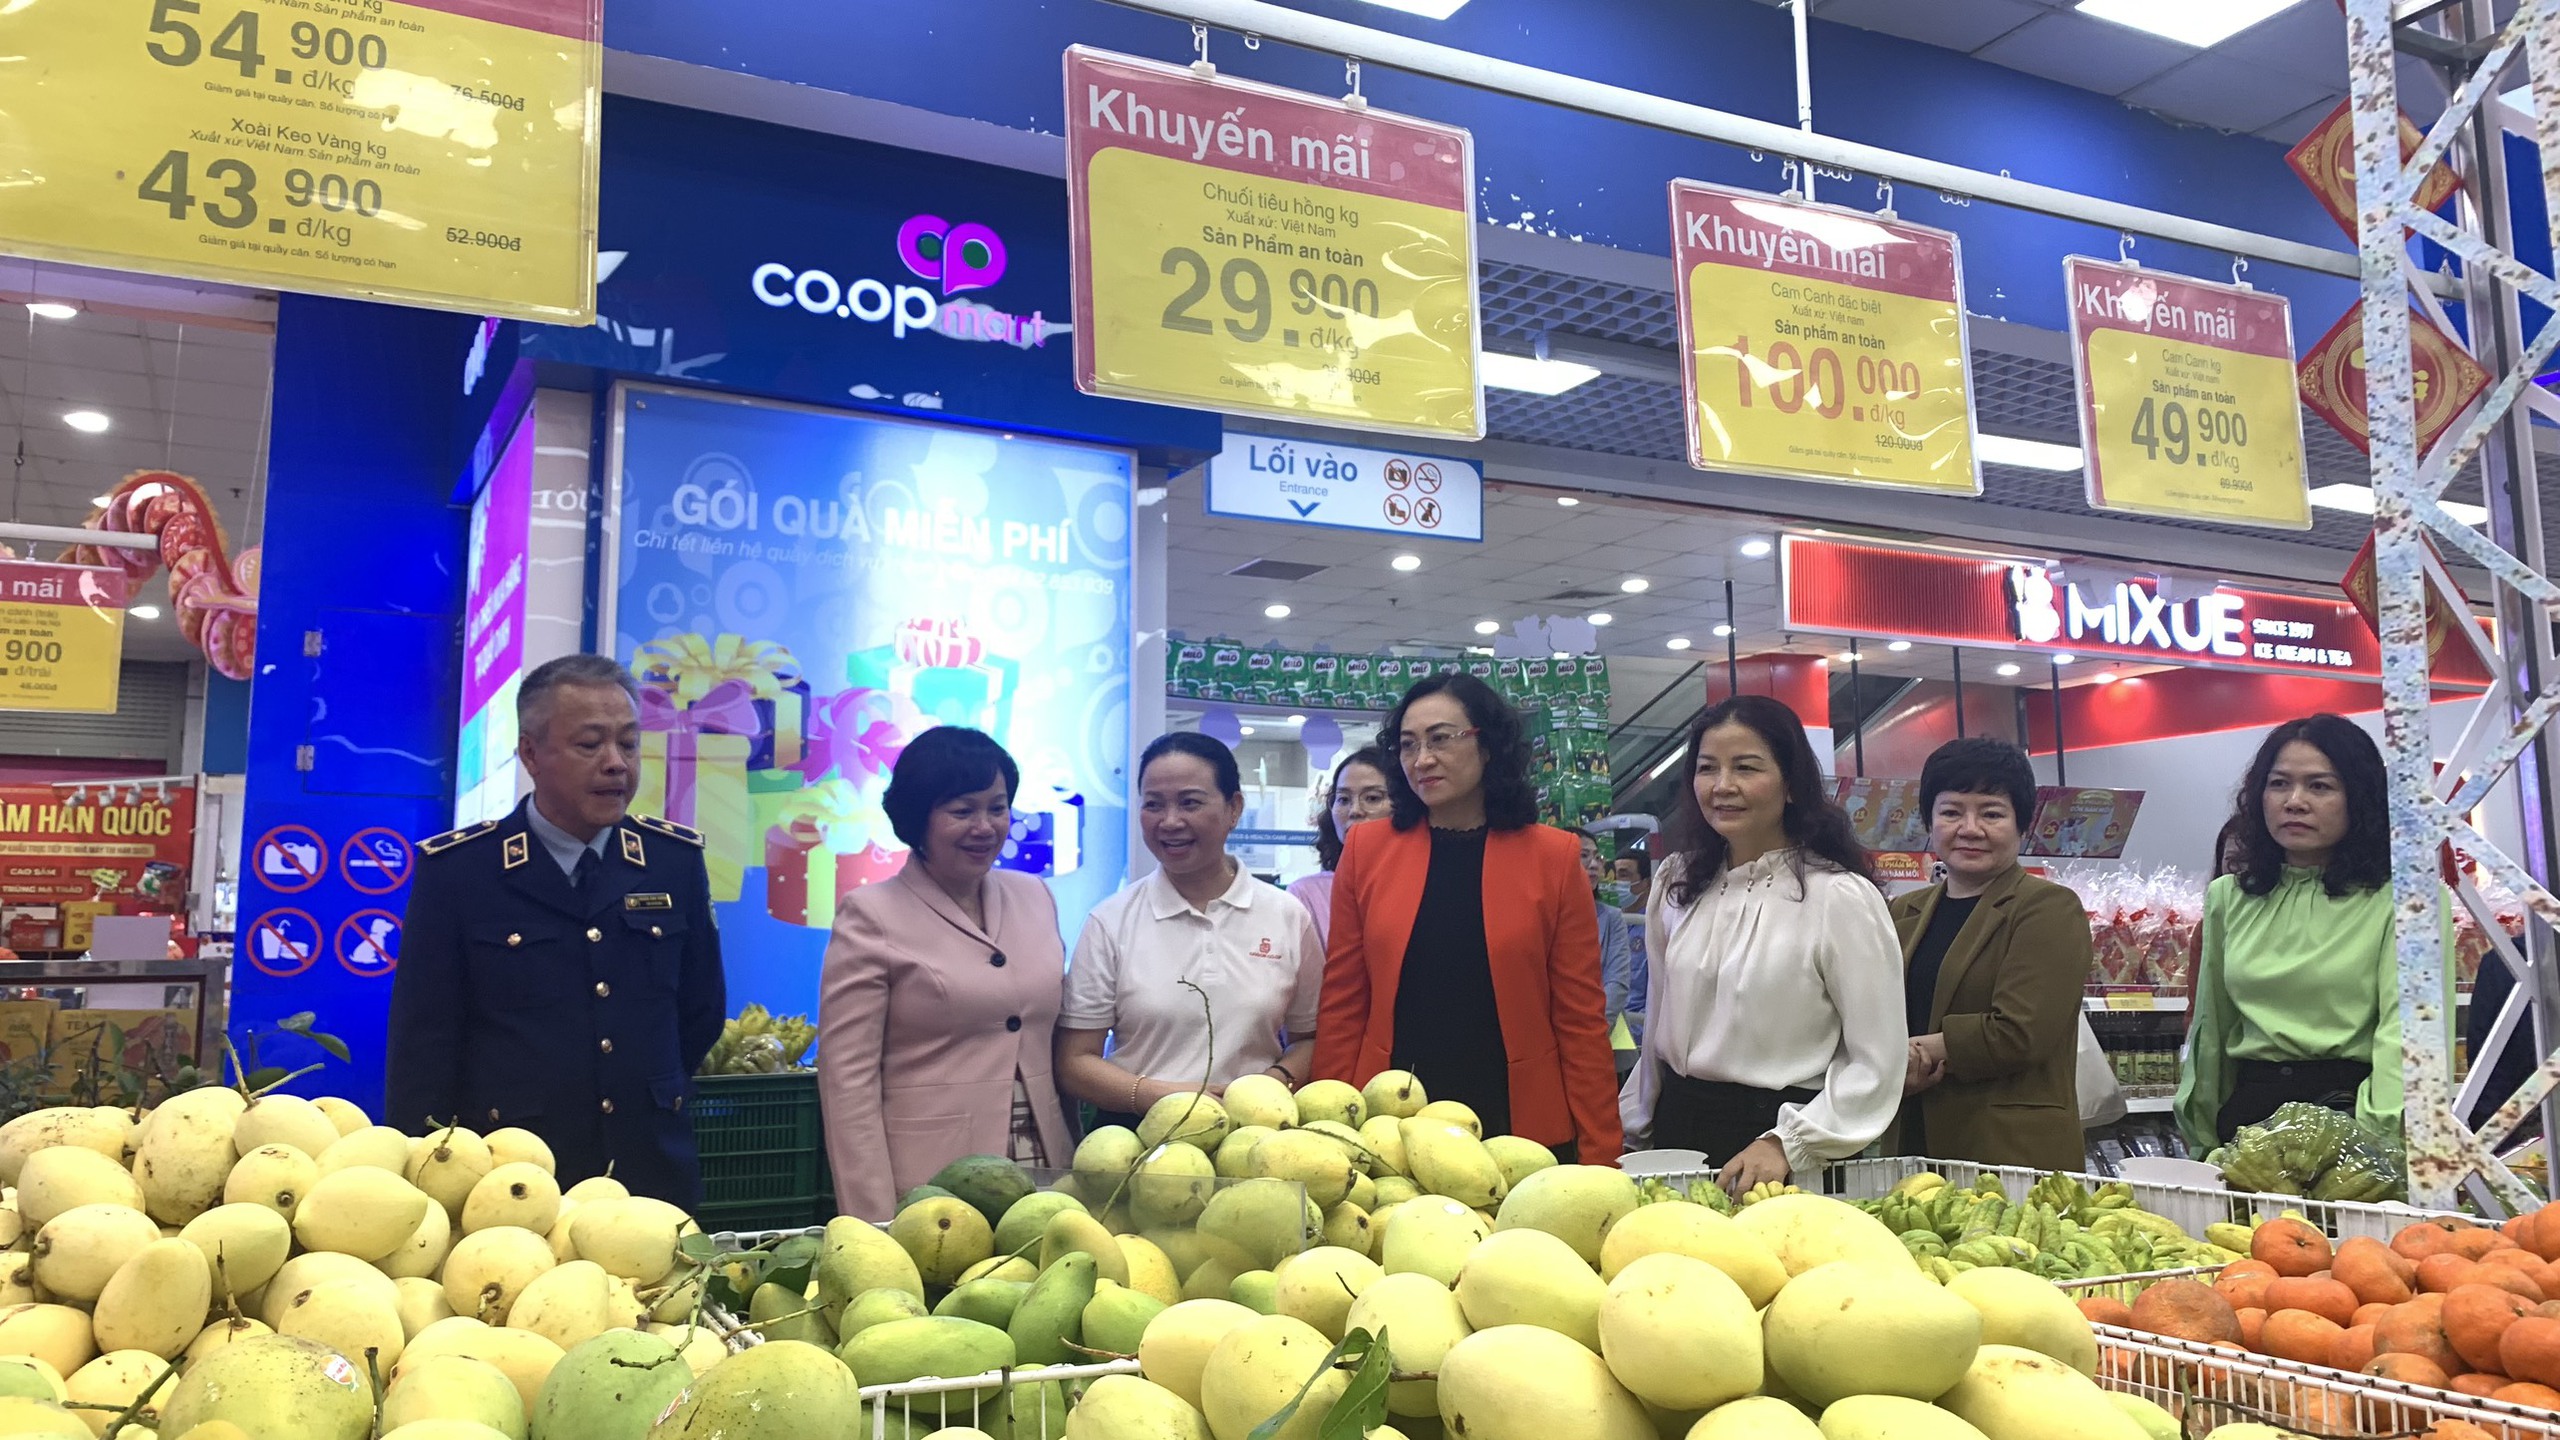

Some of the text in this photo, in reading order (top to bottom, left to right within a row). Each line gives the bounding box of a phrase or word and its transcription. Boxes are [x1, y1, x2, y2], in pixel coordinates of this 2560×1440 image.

[230, 118, 387, 159] Xoài Keo Vàng kg
[1088, 84, 1371, 180] Khuyến mãi
[375, 160, 392, 172] an
[1203, 182, 1359, 228] Chuối tiêu hồng kg
[296, 216, 352, 247] đ/kg
[1227, 208, 1256, 226] Xuất
[1281, 218, 1305, 235] Việt
[1307, 223, 1336, 238] Nam
[1243, 232, 1294, 256] Phẩm
[1299, 245, 1320, 260] an
[1326, 247, 1364, 267] toàn
[1771, 281, 1800, 299] Cam
[1803, 287, 1835, 306] Canh
[1861, 297, 1882, 315] biệt
[1803, 323, 1838, 342] phẩm
[1841, 332, 1856, 344] an
[1859, 334, 1886, 350] toàn
[2194, 307, 2236, 340] mãi
[2200, 390, 2213, 401] an
[1870, 404, 1906, 430] đ/kg
[1250, 443, 1359, 482] Lối vào
[2211, 450, 2239, 473] đ/kg
[1279, 480, 1329, 497] Entrance
[672, 478, 758, 531] GÓI
[772, 492, 871, 543] QUÀ
[1003, 517, 1073, 564] PHÍ
[633, 529, 667, 550] Chi
[12, 577, 64, 599] mãi
[2066, 580, 2247, 657] MIXUE
[2253, 642, 2274, 659] ICE
[2275, 644, 2317, 663] CREAM
[2327, 649, 2353, 667] TEA
[102, 799, 173, 836] QUỐC
